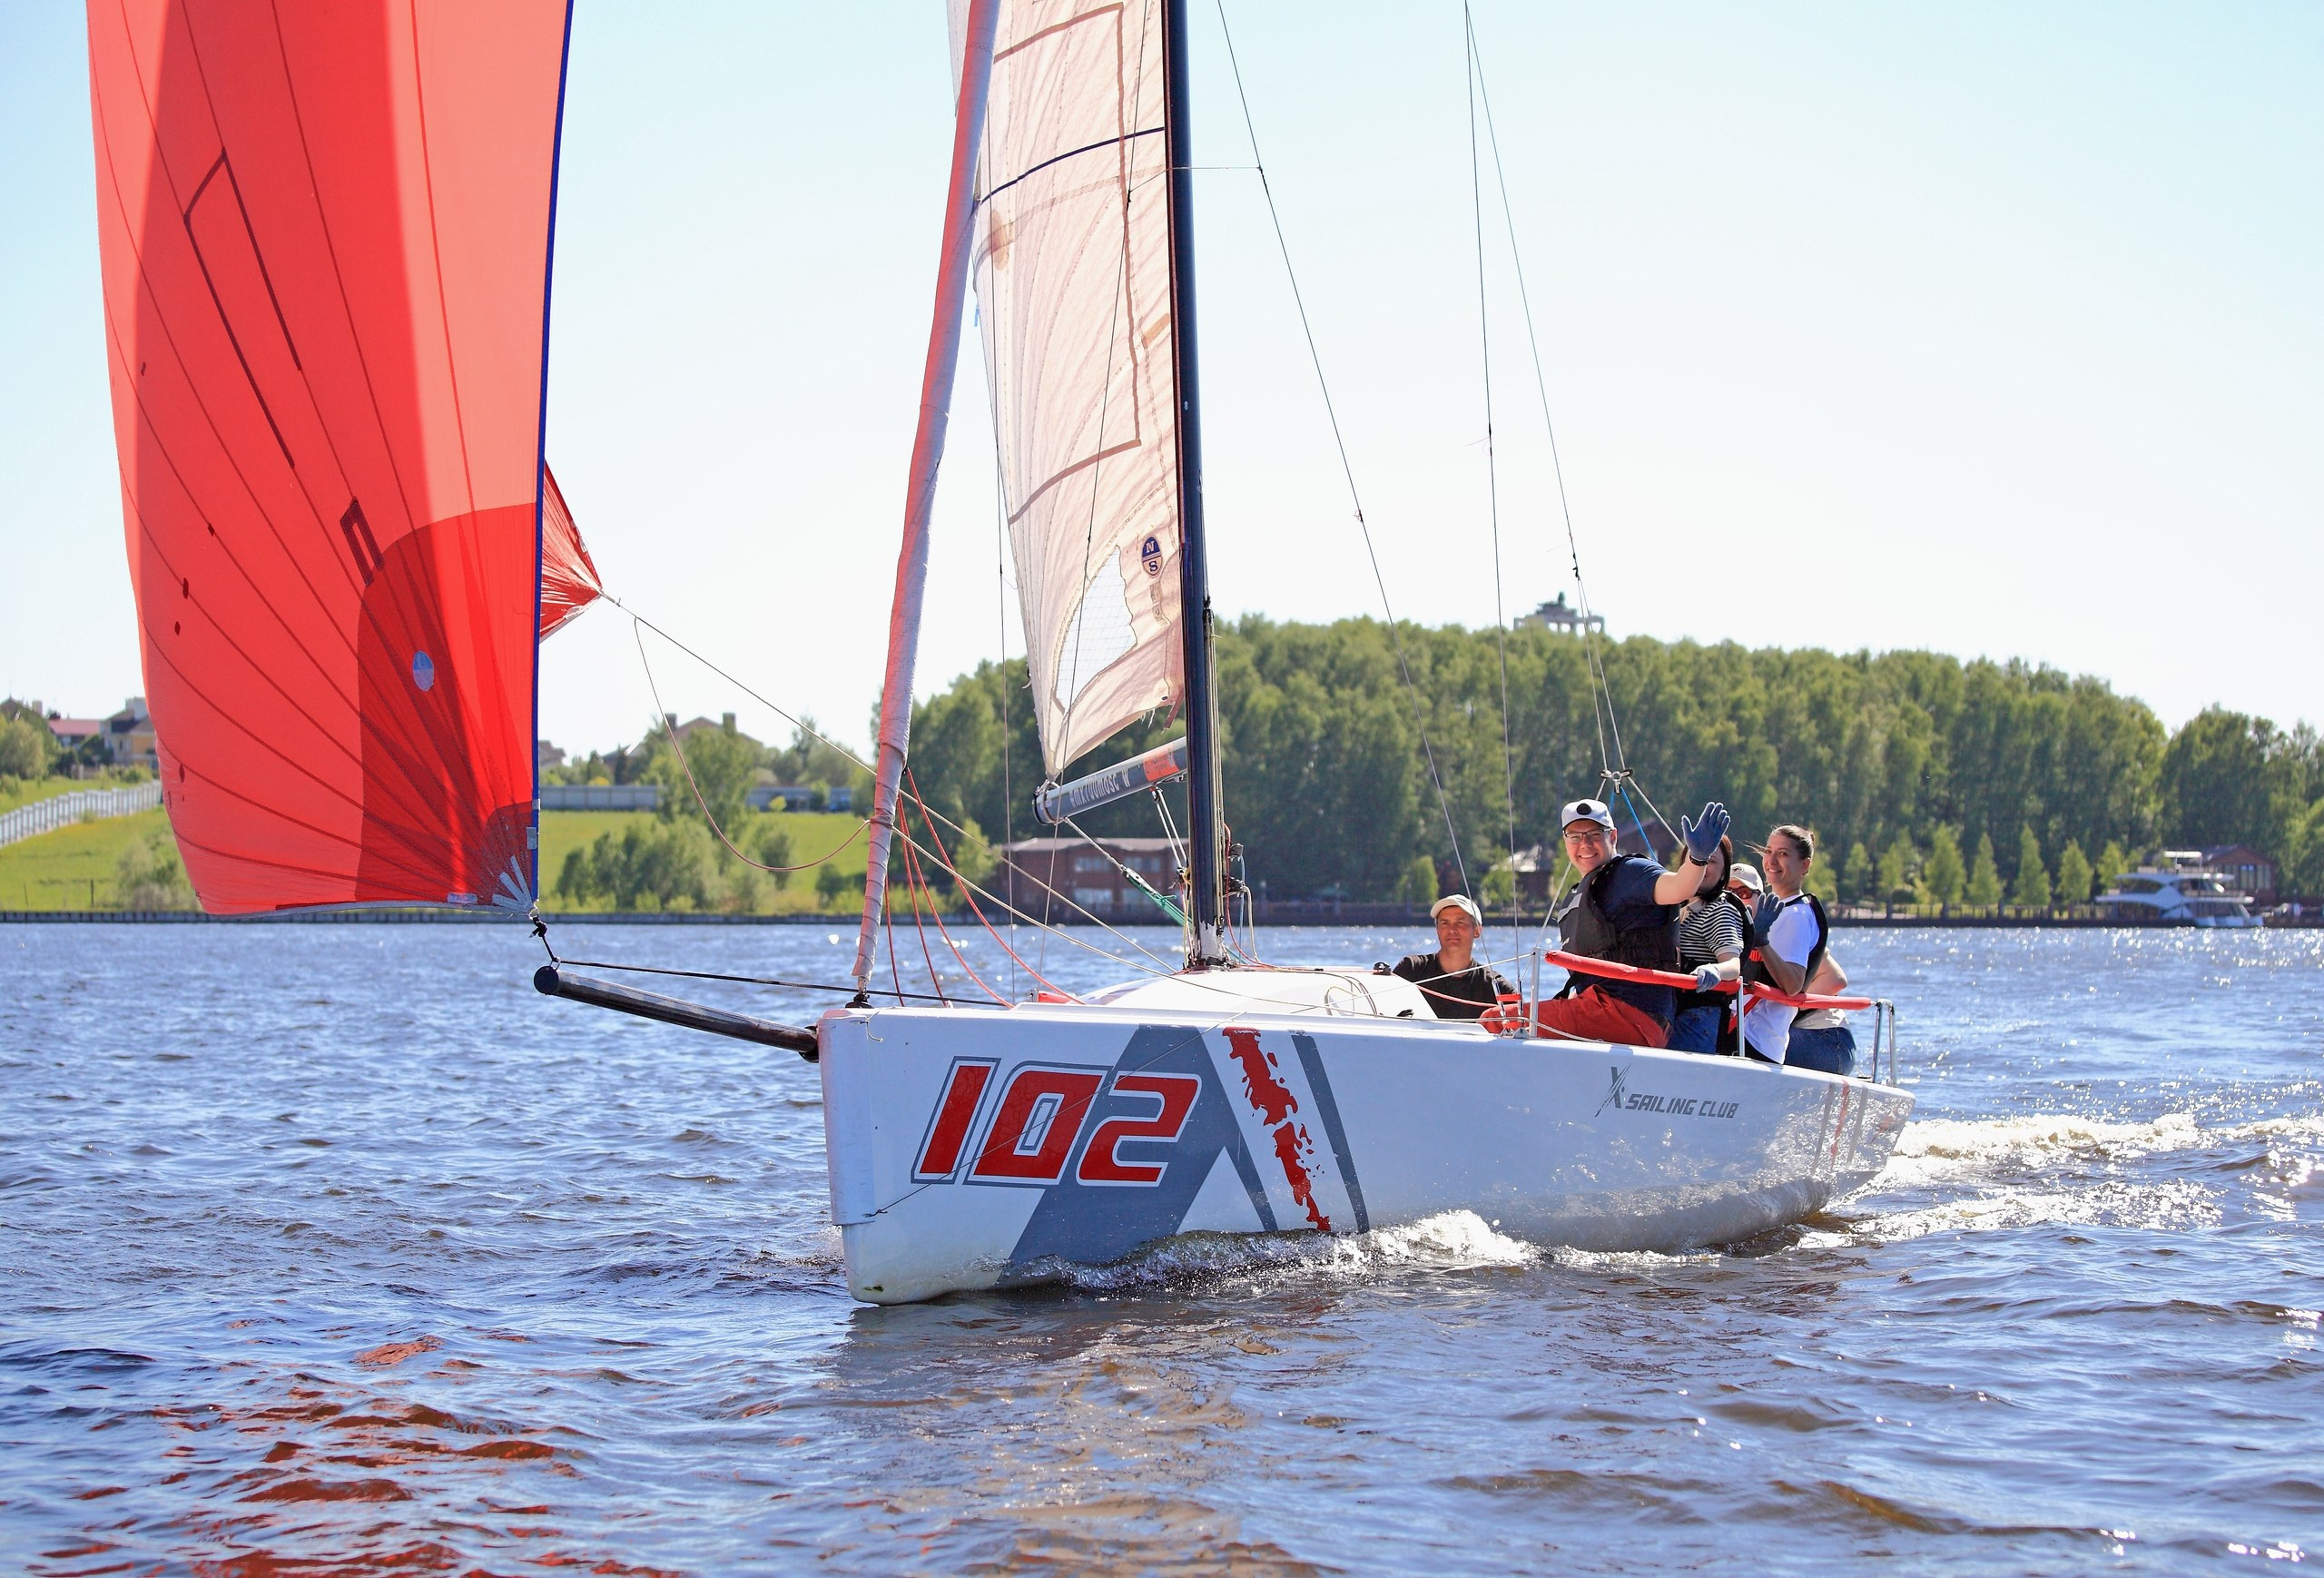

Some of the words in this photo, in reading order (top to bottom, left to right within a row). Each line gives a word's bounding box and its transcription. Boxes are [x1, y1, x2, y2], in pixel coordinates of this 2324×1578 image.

[911, 1057, 1201, 1188] 102
[1625, 1093, 1699, 1115] SAILING
[1698, 1100, 1740, 1119] CLUB
